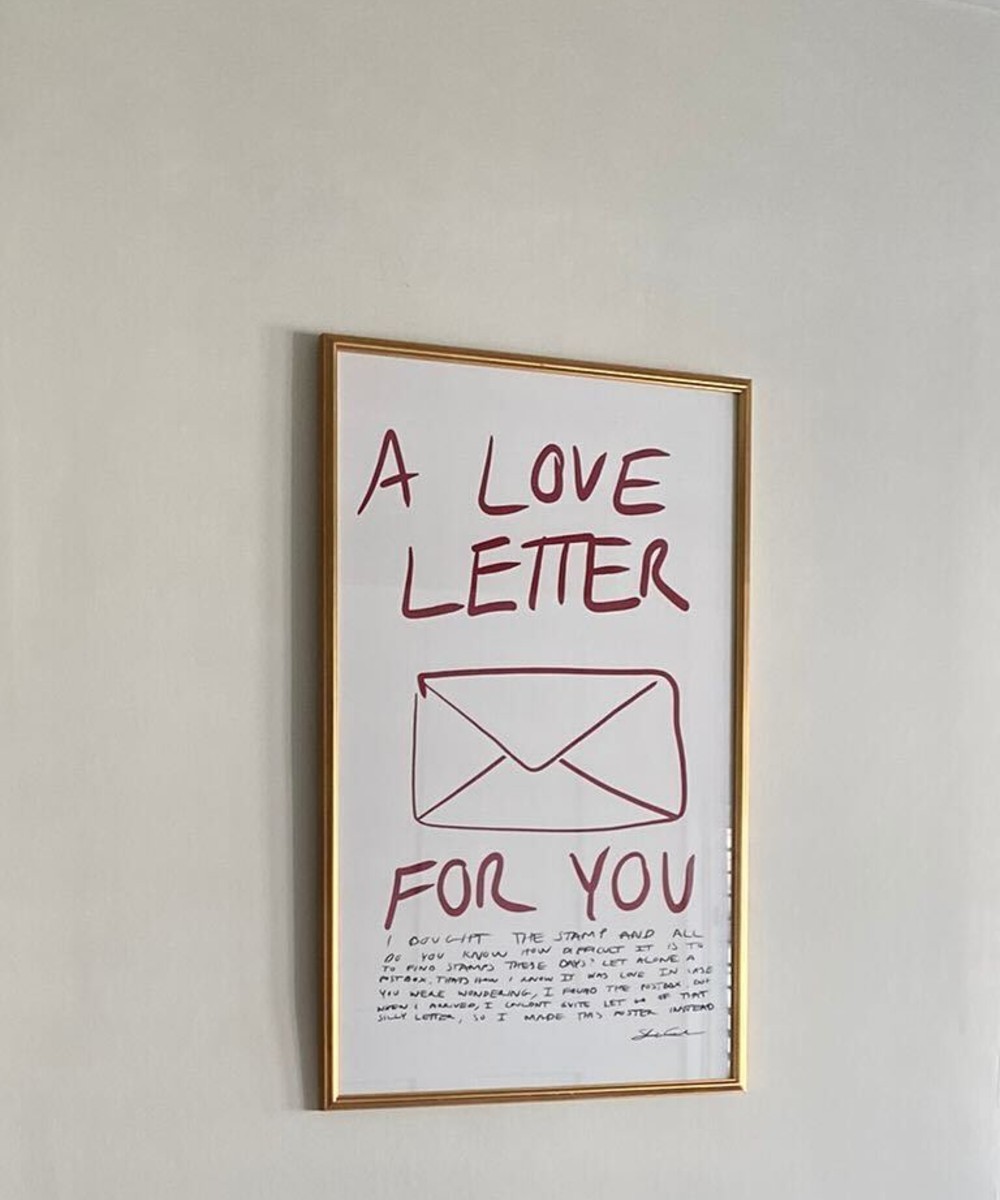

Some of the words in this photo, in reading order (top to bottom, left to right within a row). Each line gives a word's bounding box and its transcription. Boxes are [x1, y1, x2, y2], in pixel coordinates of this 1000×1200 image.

[358, 429, 419, 514] A
[479, 435, 670, 516] LOVE
[402, 533, 689, 618] LETTER
[385, 852, 537, 929] FOR
[570, 847, 695, 919] YOU
[512, 932, 543, 944] THE
[554, 928, 607, 940] STAMP
[619, 929, 655, 940] AND
[672, 929, 704, 938] ALL
[384, 953, 401, 963] DO
[422, 953, 445, 961] YOU
[462, 951, 507, 960] KNOW
[522, 946, 552, 956] HOW
[635, 944, 653, 952] IT
[668, 942, 678, 950] IS
[447, 963, 494, 972] STAMPS
[505, 961, 547, 970] THESE
[603, 959, 627, 967] LET
[637, 955, 678, 964] ALONE
[560, 974, 574, 982] IT
[660, 968, 678, 976] IN
[688, 966, 713, 974] CASE
[377, 1004, 408, 1012] WHEN
[604, 999, 625, 1007] LET
[680, 991, 708, 999] THAT
[379, 989, 399, 998] YOU
[410, 990, 445, 998] WERE
[544, 987, 553, 997] I
[562, 987, 597, 995] FOUND
[378, 1013, 407, 1022] SILLY
[498, 1013, 507, 1021] I
[524, 1013, 564, 1021] MADE
[614, 1009, 657, 1018] POSTER
[670, 1003, 715, 1013] INSTEAD
